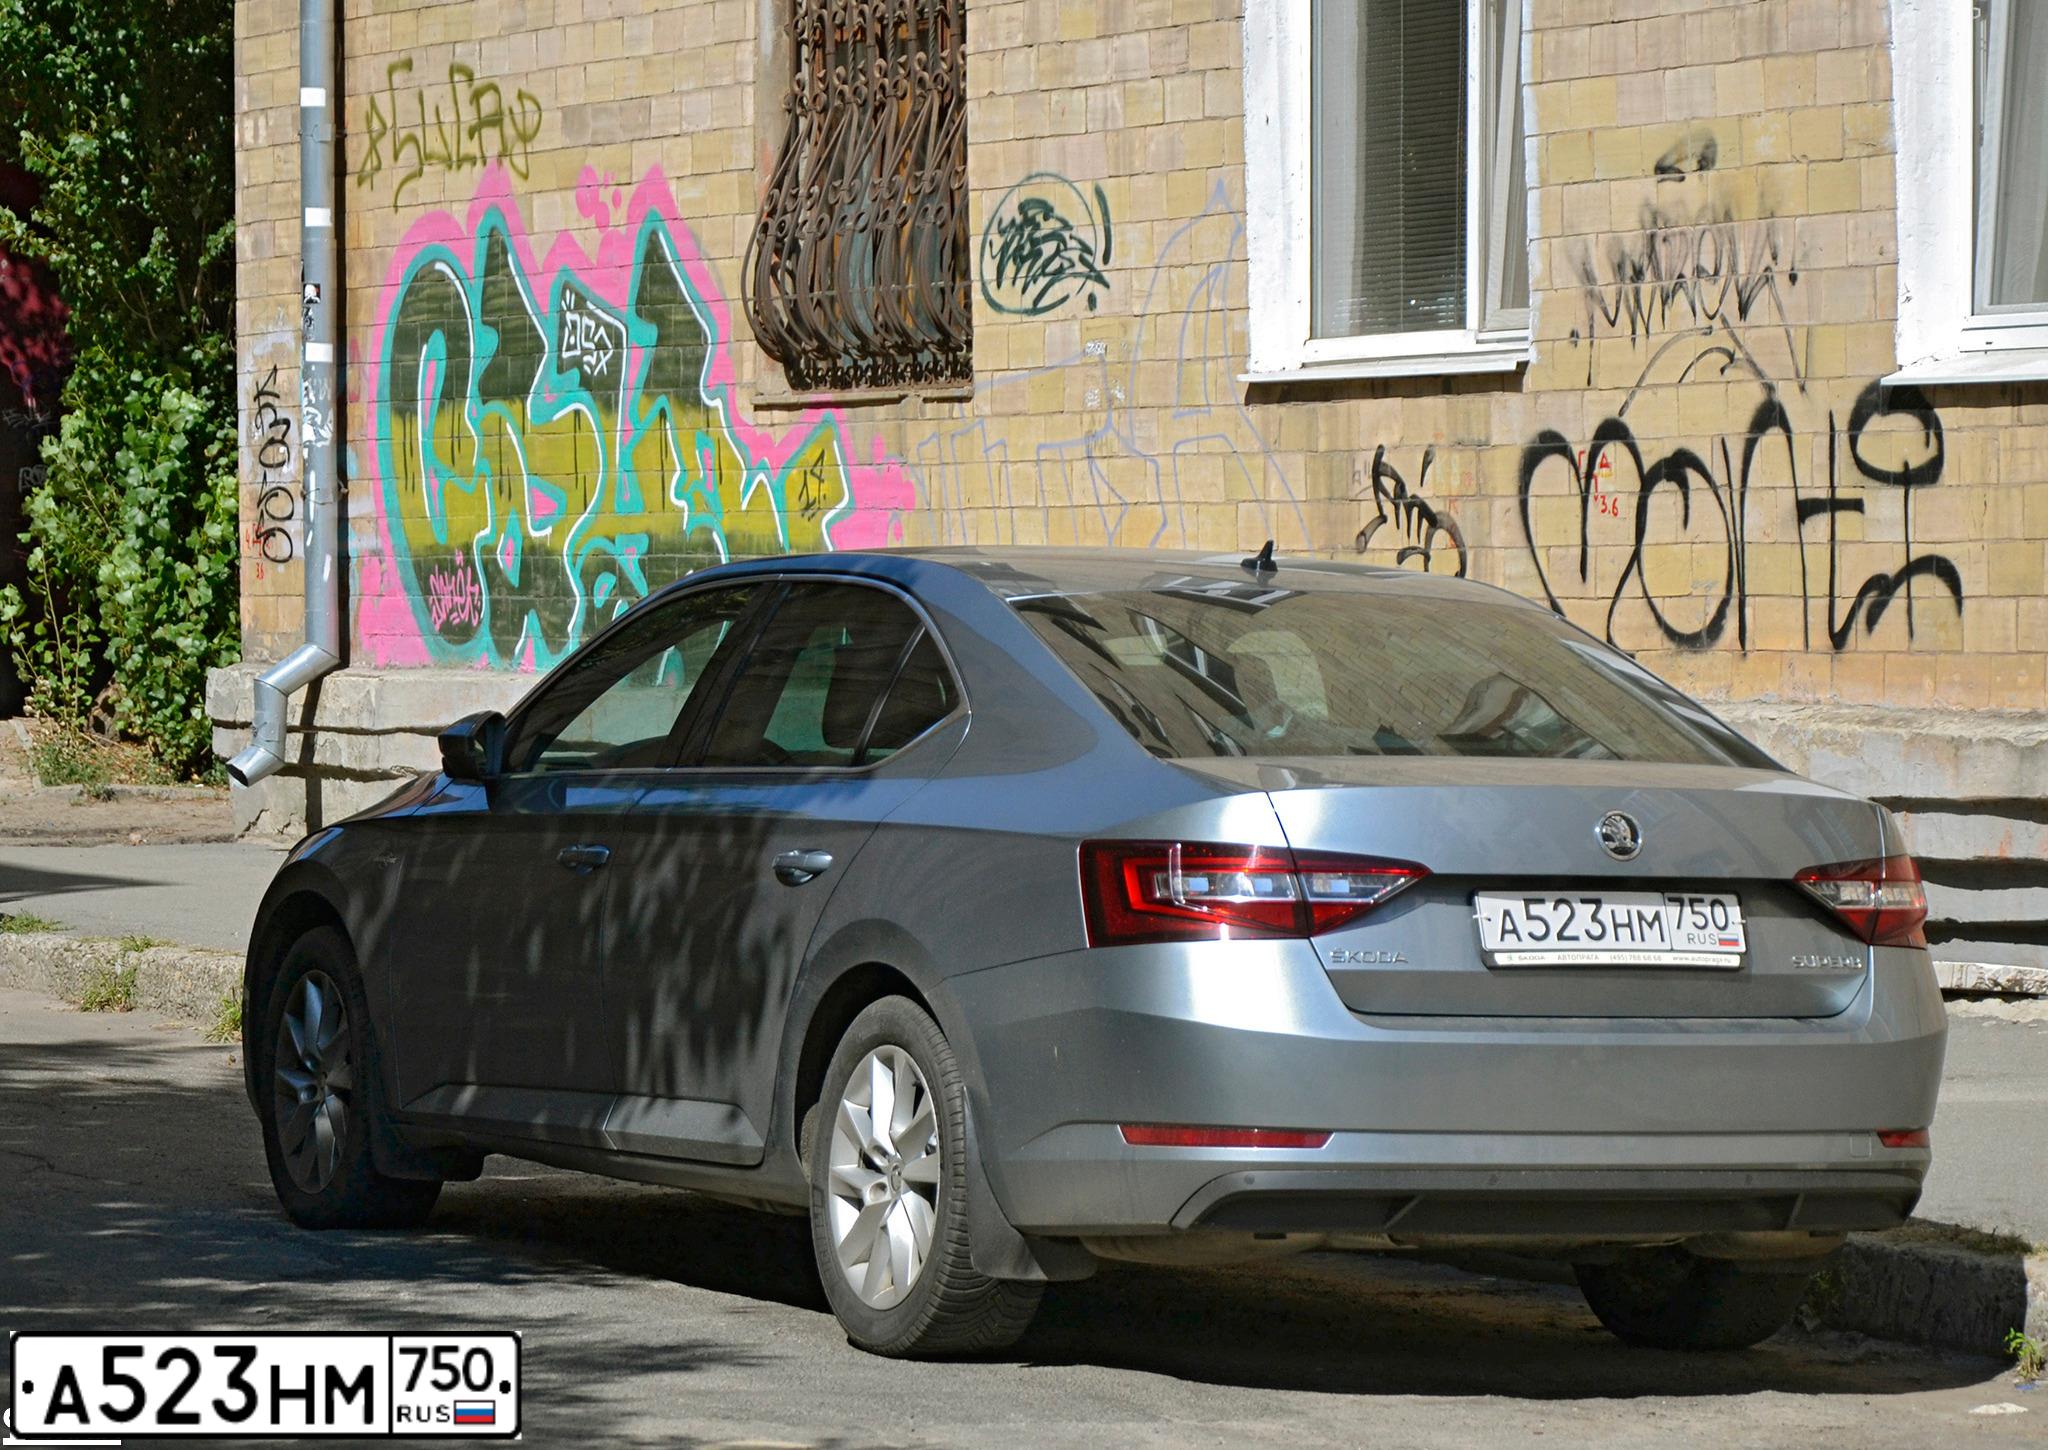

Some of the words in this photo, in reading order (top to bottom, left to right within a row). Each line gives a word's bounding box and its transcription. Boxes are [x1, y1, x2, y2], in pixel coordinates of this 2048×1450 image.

[1499, 897, 1666, 943] А523НМ
[1667, 896, 1729, 931] 750
[1687, 932, 1718, 946] RUS
